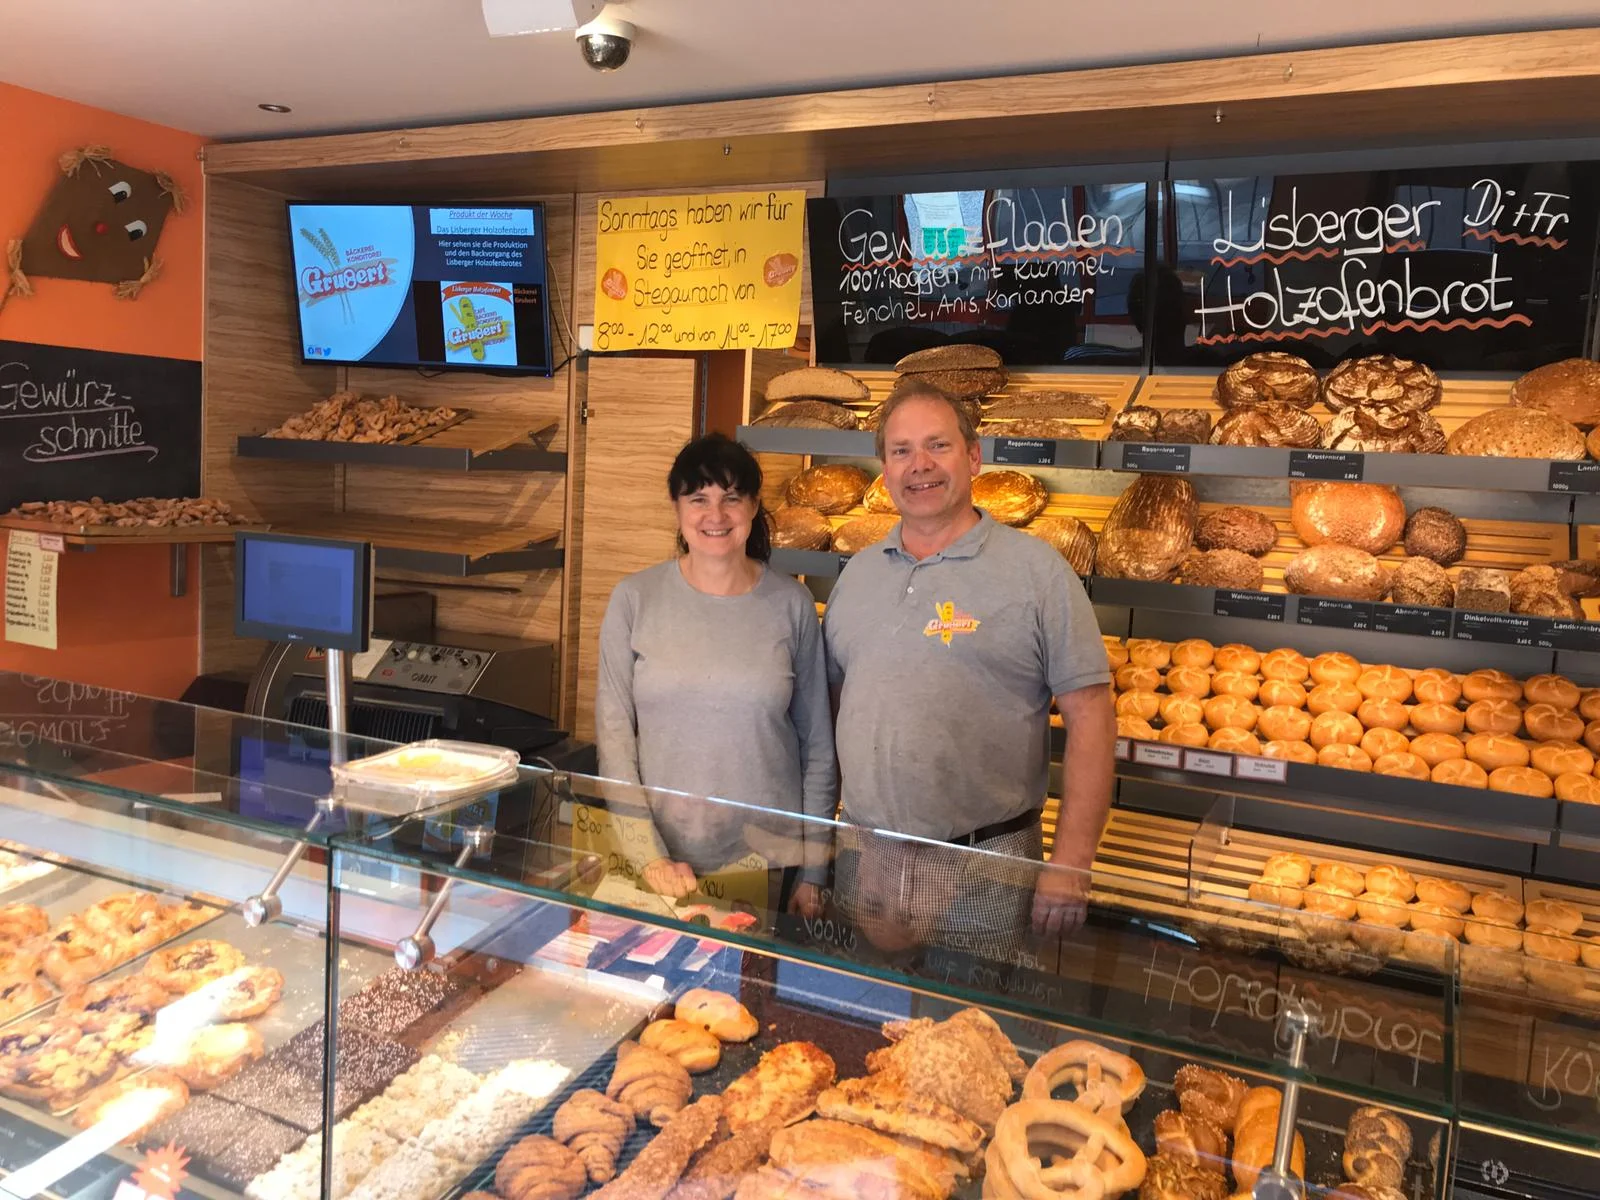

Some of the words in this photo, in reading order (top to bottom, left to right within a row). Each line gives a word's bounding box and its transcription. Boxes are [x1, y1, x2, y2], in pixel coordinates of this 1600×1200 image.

[449, 209, 476, 219] Produkt
[477, 210, 489, 219] der
[490, 209, 514, 220] Woche
[600, 200, 678, 241] Sonntags
[687, 196, 732, 226] haben
[739, 198, 763, 220] wir
[767, 192, 793, 222] für
[1213, 187, 1441, 256] Lisberger
[436, 225, 450, 235] Das
[451, 226, 481, 236] Lisberger
[438, 240, 451, 249] Hier
[452, 241, 469, 249] sehen
[470, 241, 480, 249] sie
[480, 241, 491, 249] die
[493, 241, 528, 250] Produktion
[445, 250, 458, 258] und
[458, 250, 470, 258] den
[471, 250, 510, 259] Backvorgang
[511, 250, 523, 259] des
[446, 259, 474, 268] Lisberger
[636, 243, 658, 270] Sie
[734, 241, 747, 264] in
[887, 266, 960, 296] Roggen
[970, 262, 1003, 284] mit
[634, 274, 729, 315] Stegaurach
[732, 282, 756, 301] von
[985, 284, 1095, 313] Koriander
[1195, 253, 1514, 338] Holzofenbrot
[674, 328, 695, 344] und
[698, 329, 716, 343] von
[36, 411, 146, 456] schnitte
[1464, 614, 1530, 626] Dinkelvollkornbrot
